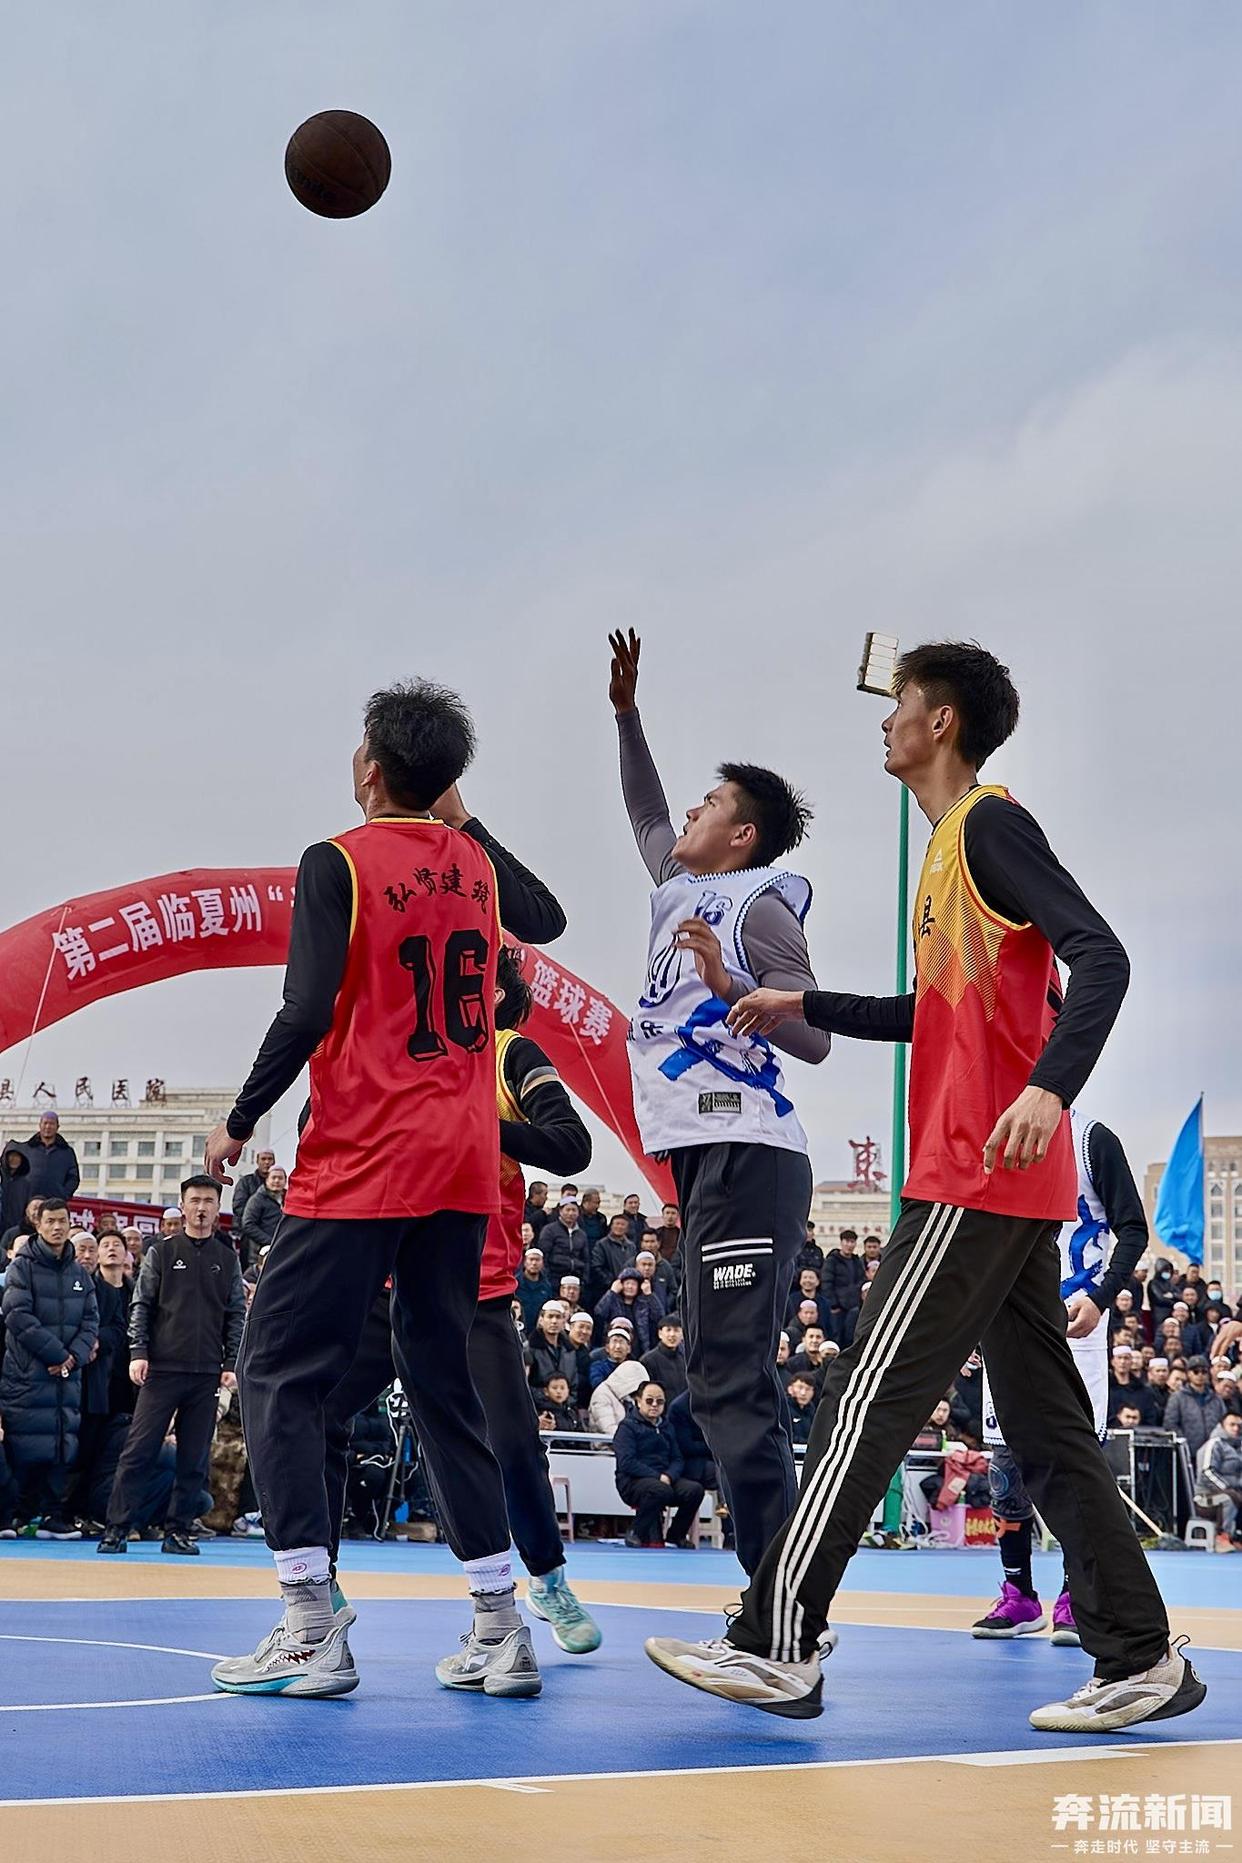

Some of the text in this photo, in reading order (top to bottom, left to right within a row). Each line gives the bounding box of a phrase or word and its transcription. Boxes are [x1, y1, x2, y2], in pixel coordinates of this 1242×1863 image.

[398, 928, 490, 1063] 16
[0, 1076, 167, 1102] 县人民医院
